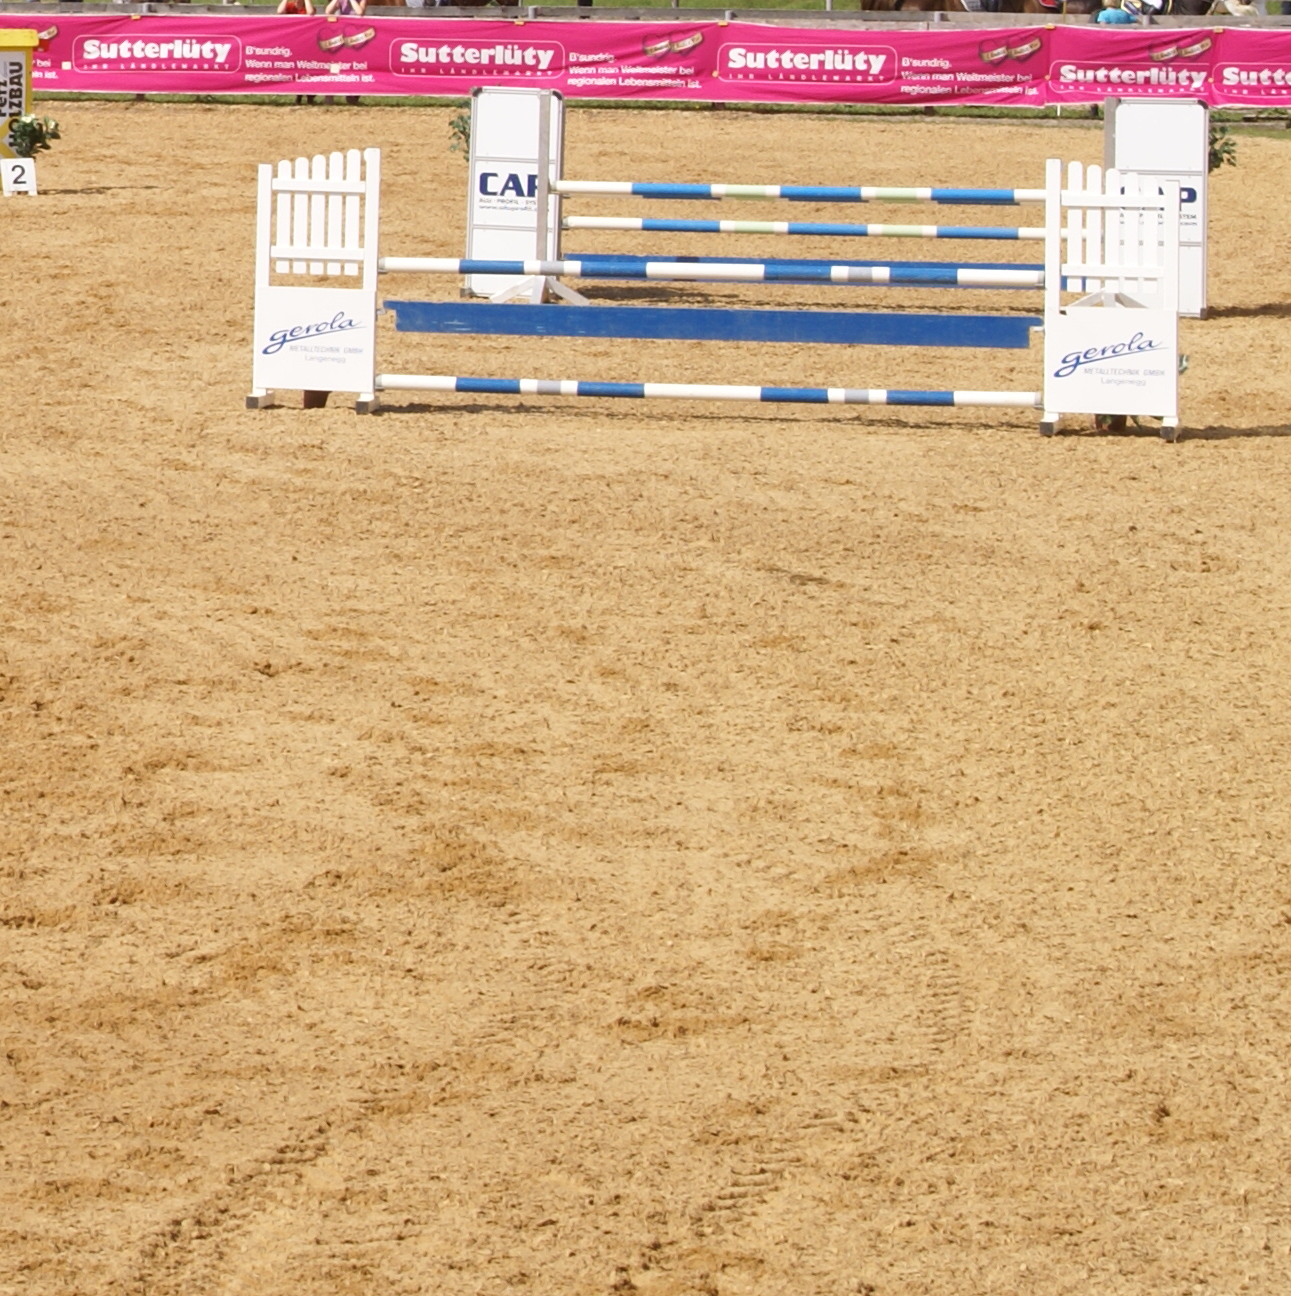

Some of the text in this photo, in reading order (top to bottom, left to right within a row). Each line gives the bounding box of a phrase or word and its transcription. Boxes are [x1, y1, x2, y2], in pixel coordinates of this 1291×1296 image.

[83, 39, 232, 63] Sutterlüty
[400, 43, 555, 70] Sutterlüty
[728, 48, 887, 74] Sutterlüty
[1059, 65, 1208, 89] Sutterlüty
[11, 164, 27, 185] 2
[262, 311, 363, 355] gerola
[1053, 332, 1164, 378] gerola
